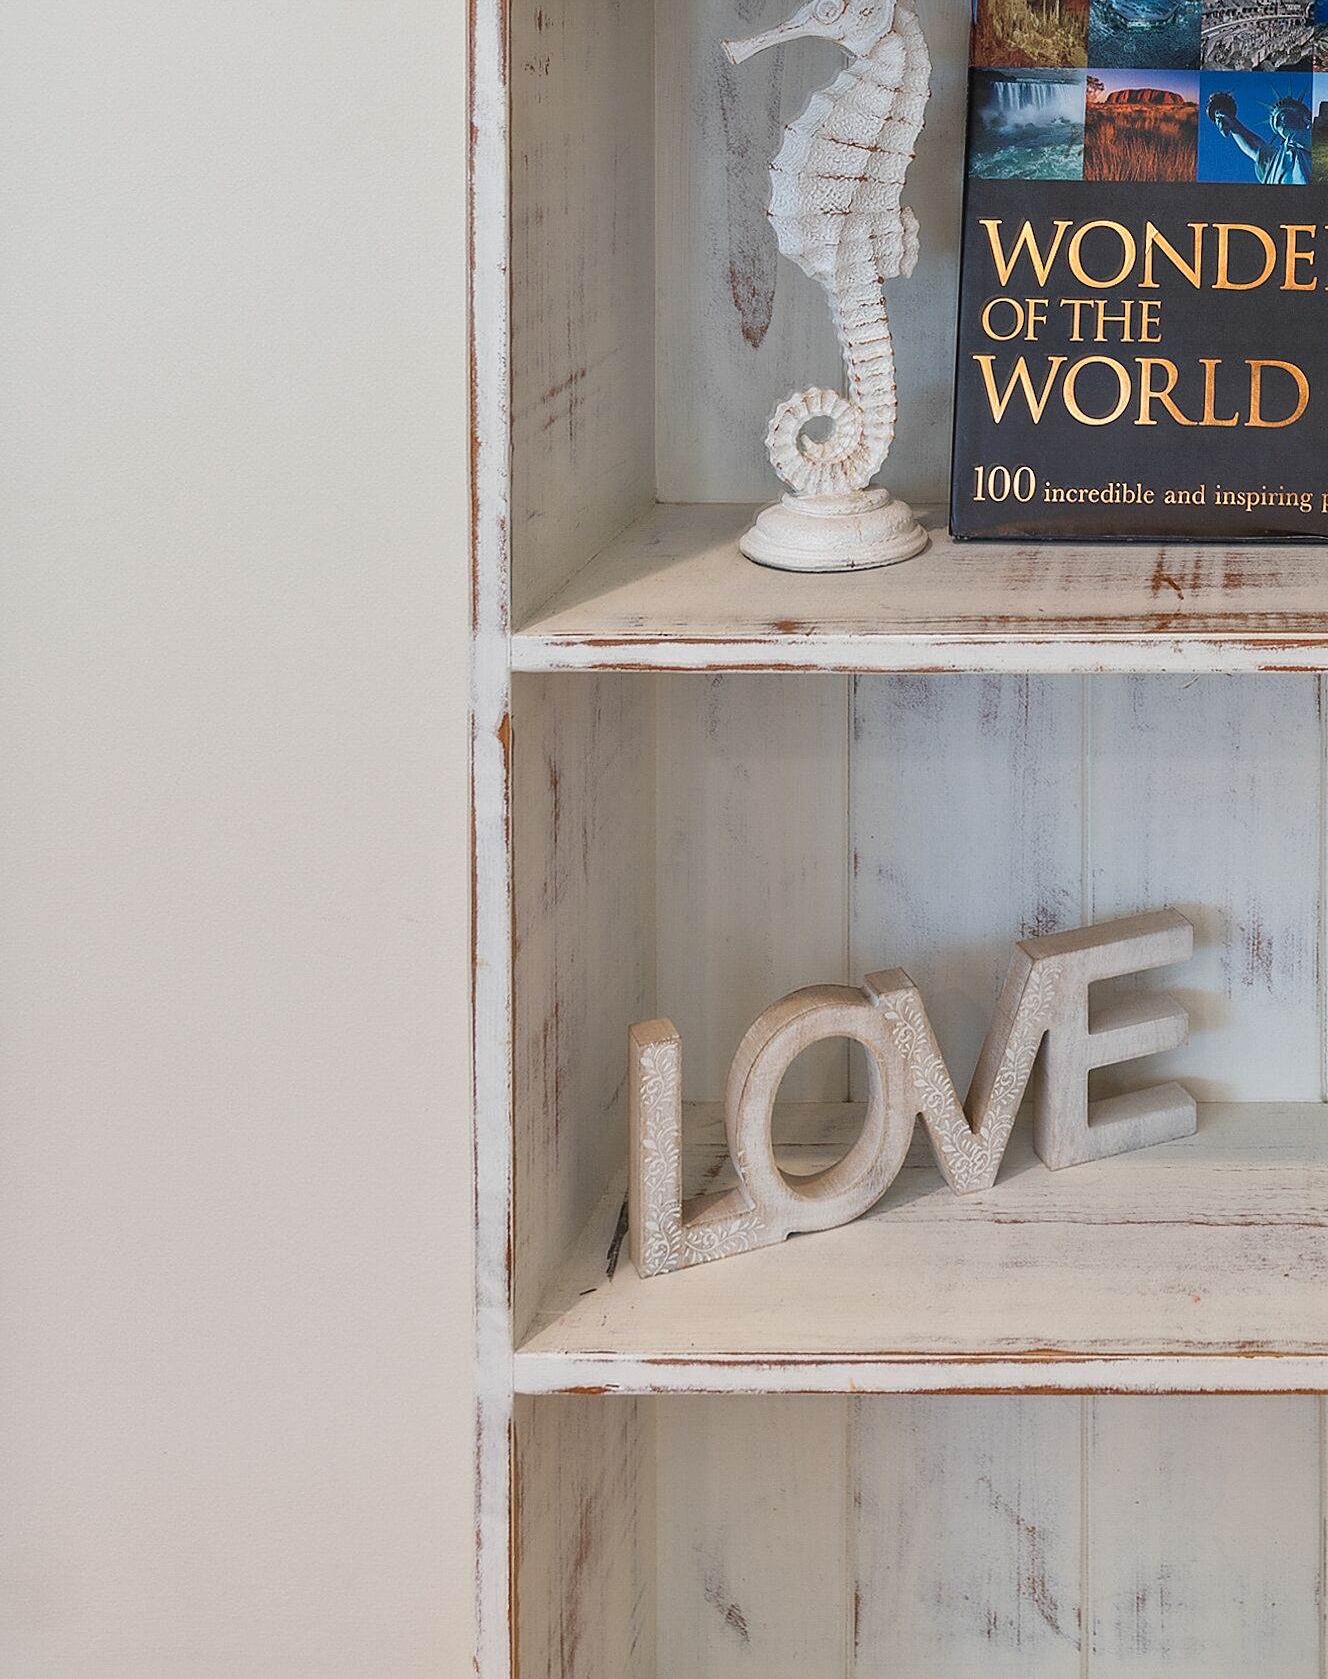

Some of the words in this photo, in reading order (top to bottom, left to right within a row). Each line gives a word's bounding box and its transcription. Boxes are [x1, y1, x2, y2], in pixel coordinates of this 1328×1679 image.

[980, 297, 1049, 342] OF
[1060, 298, 1163, 344] THE
[972, 353, 1311, 429] WORLD
[972, 465, 1037, 503] 100
[1043, 481, 1155, 505] incredible
[1163, 484, 1206, 505] and
[1214, 484, 1314, 513] inspiring
[629, 907, 1198, 1280] LOVE
